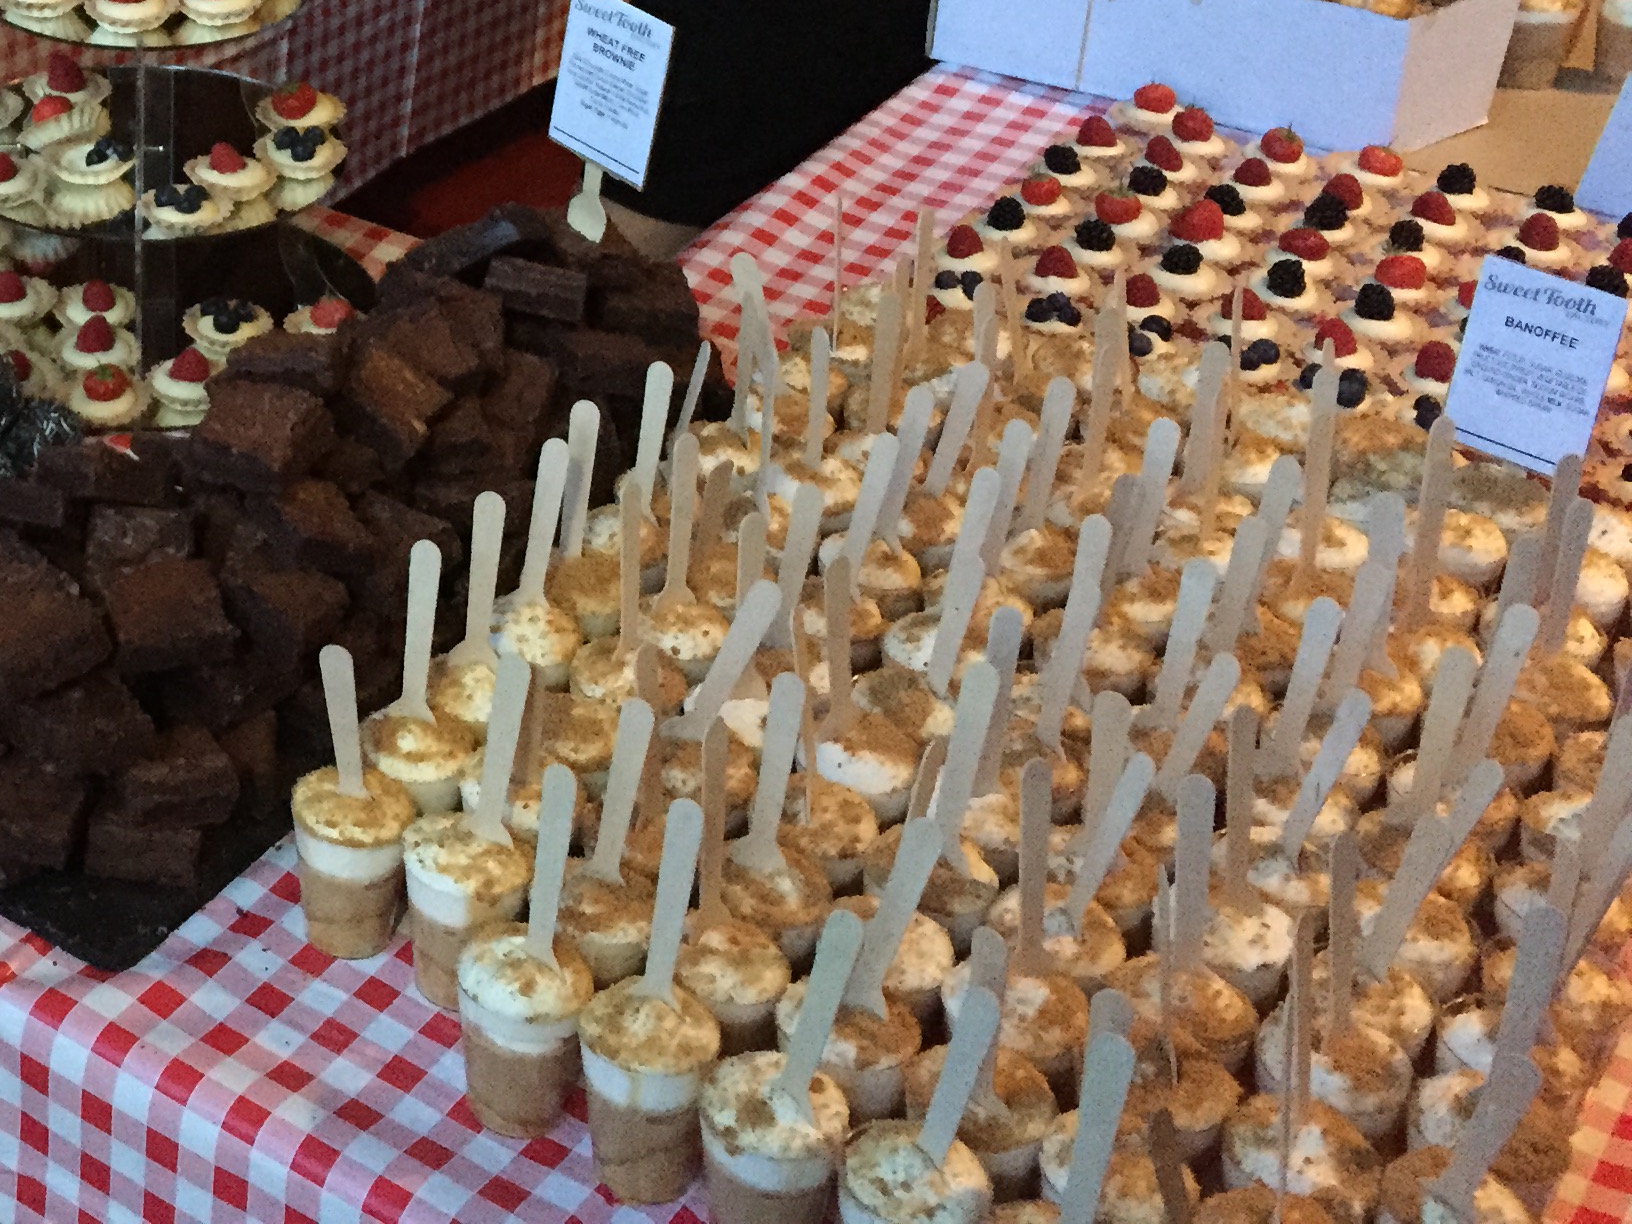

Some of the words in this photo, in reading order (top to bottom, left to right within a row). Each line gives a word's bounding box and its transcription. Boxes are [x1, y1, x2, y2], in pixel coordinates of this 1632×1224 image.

[615, 11, 652, 38] Tooth
[587, 26, 620, 49] WHEAT
[621, 44, 646, 63] FREE
[592, 42, 636, 71] BROWNIE
[1484, 274, 1541, 301] Sweet
[1543, 287, 1597, 316] Tooth
[1504, 316, 1580, 349] BANOFFEE
